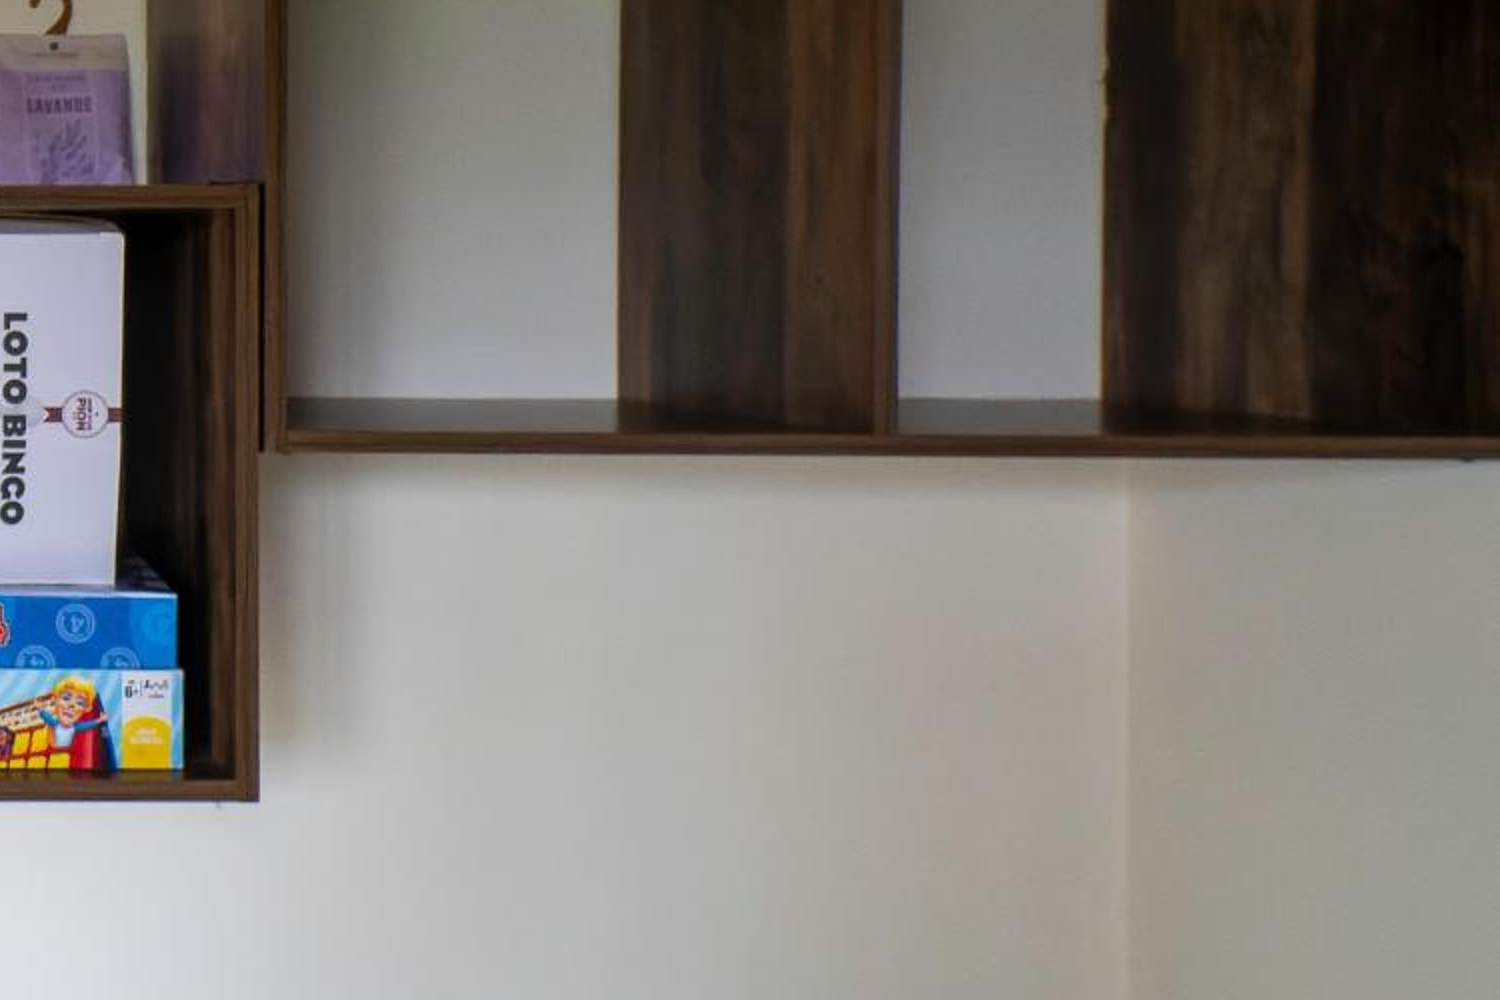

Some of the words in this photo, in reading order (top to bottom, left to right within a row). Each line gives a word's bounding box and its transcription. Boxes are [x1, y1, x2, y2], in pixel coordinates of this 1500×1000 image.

[26, 97, 93, 114] LAVANDE
[3, 312, 28, 405] LOTO
[0, 413, 26, 526] BINGO
